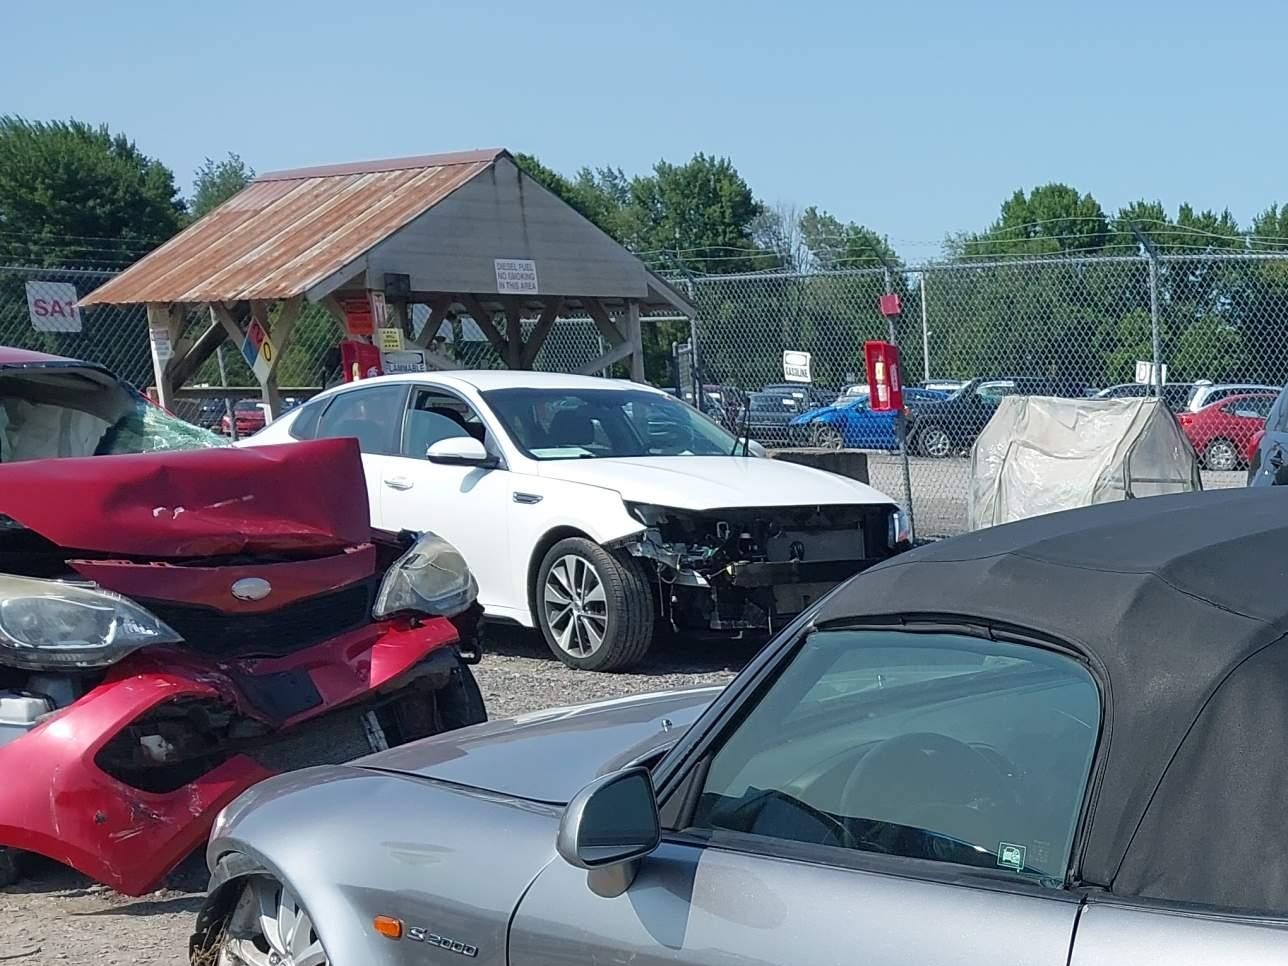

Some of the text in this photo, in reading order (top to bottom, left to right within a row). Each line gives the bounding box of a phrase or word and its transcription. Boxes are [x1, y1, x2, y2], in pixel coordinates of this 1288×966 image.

[496, 262, 534, 271] DIESEL FUEL
[497, 272, 535, 281] NO SMOKING
[499, 281, 537, 290] IN THIS AREA
[263, 342, 272, 361] 0
[785, 366, 809, 378] GASOLINE
[407, 926, 479, 957] S2000
